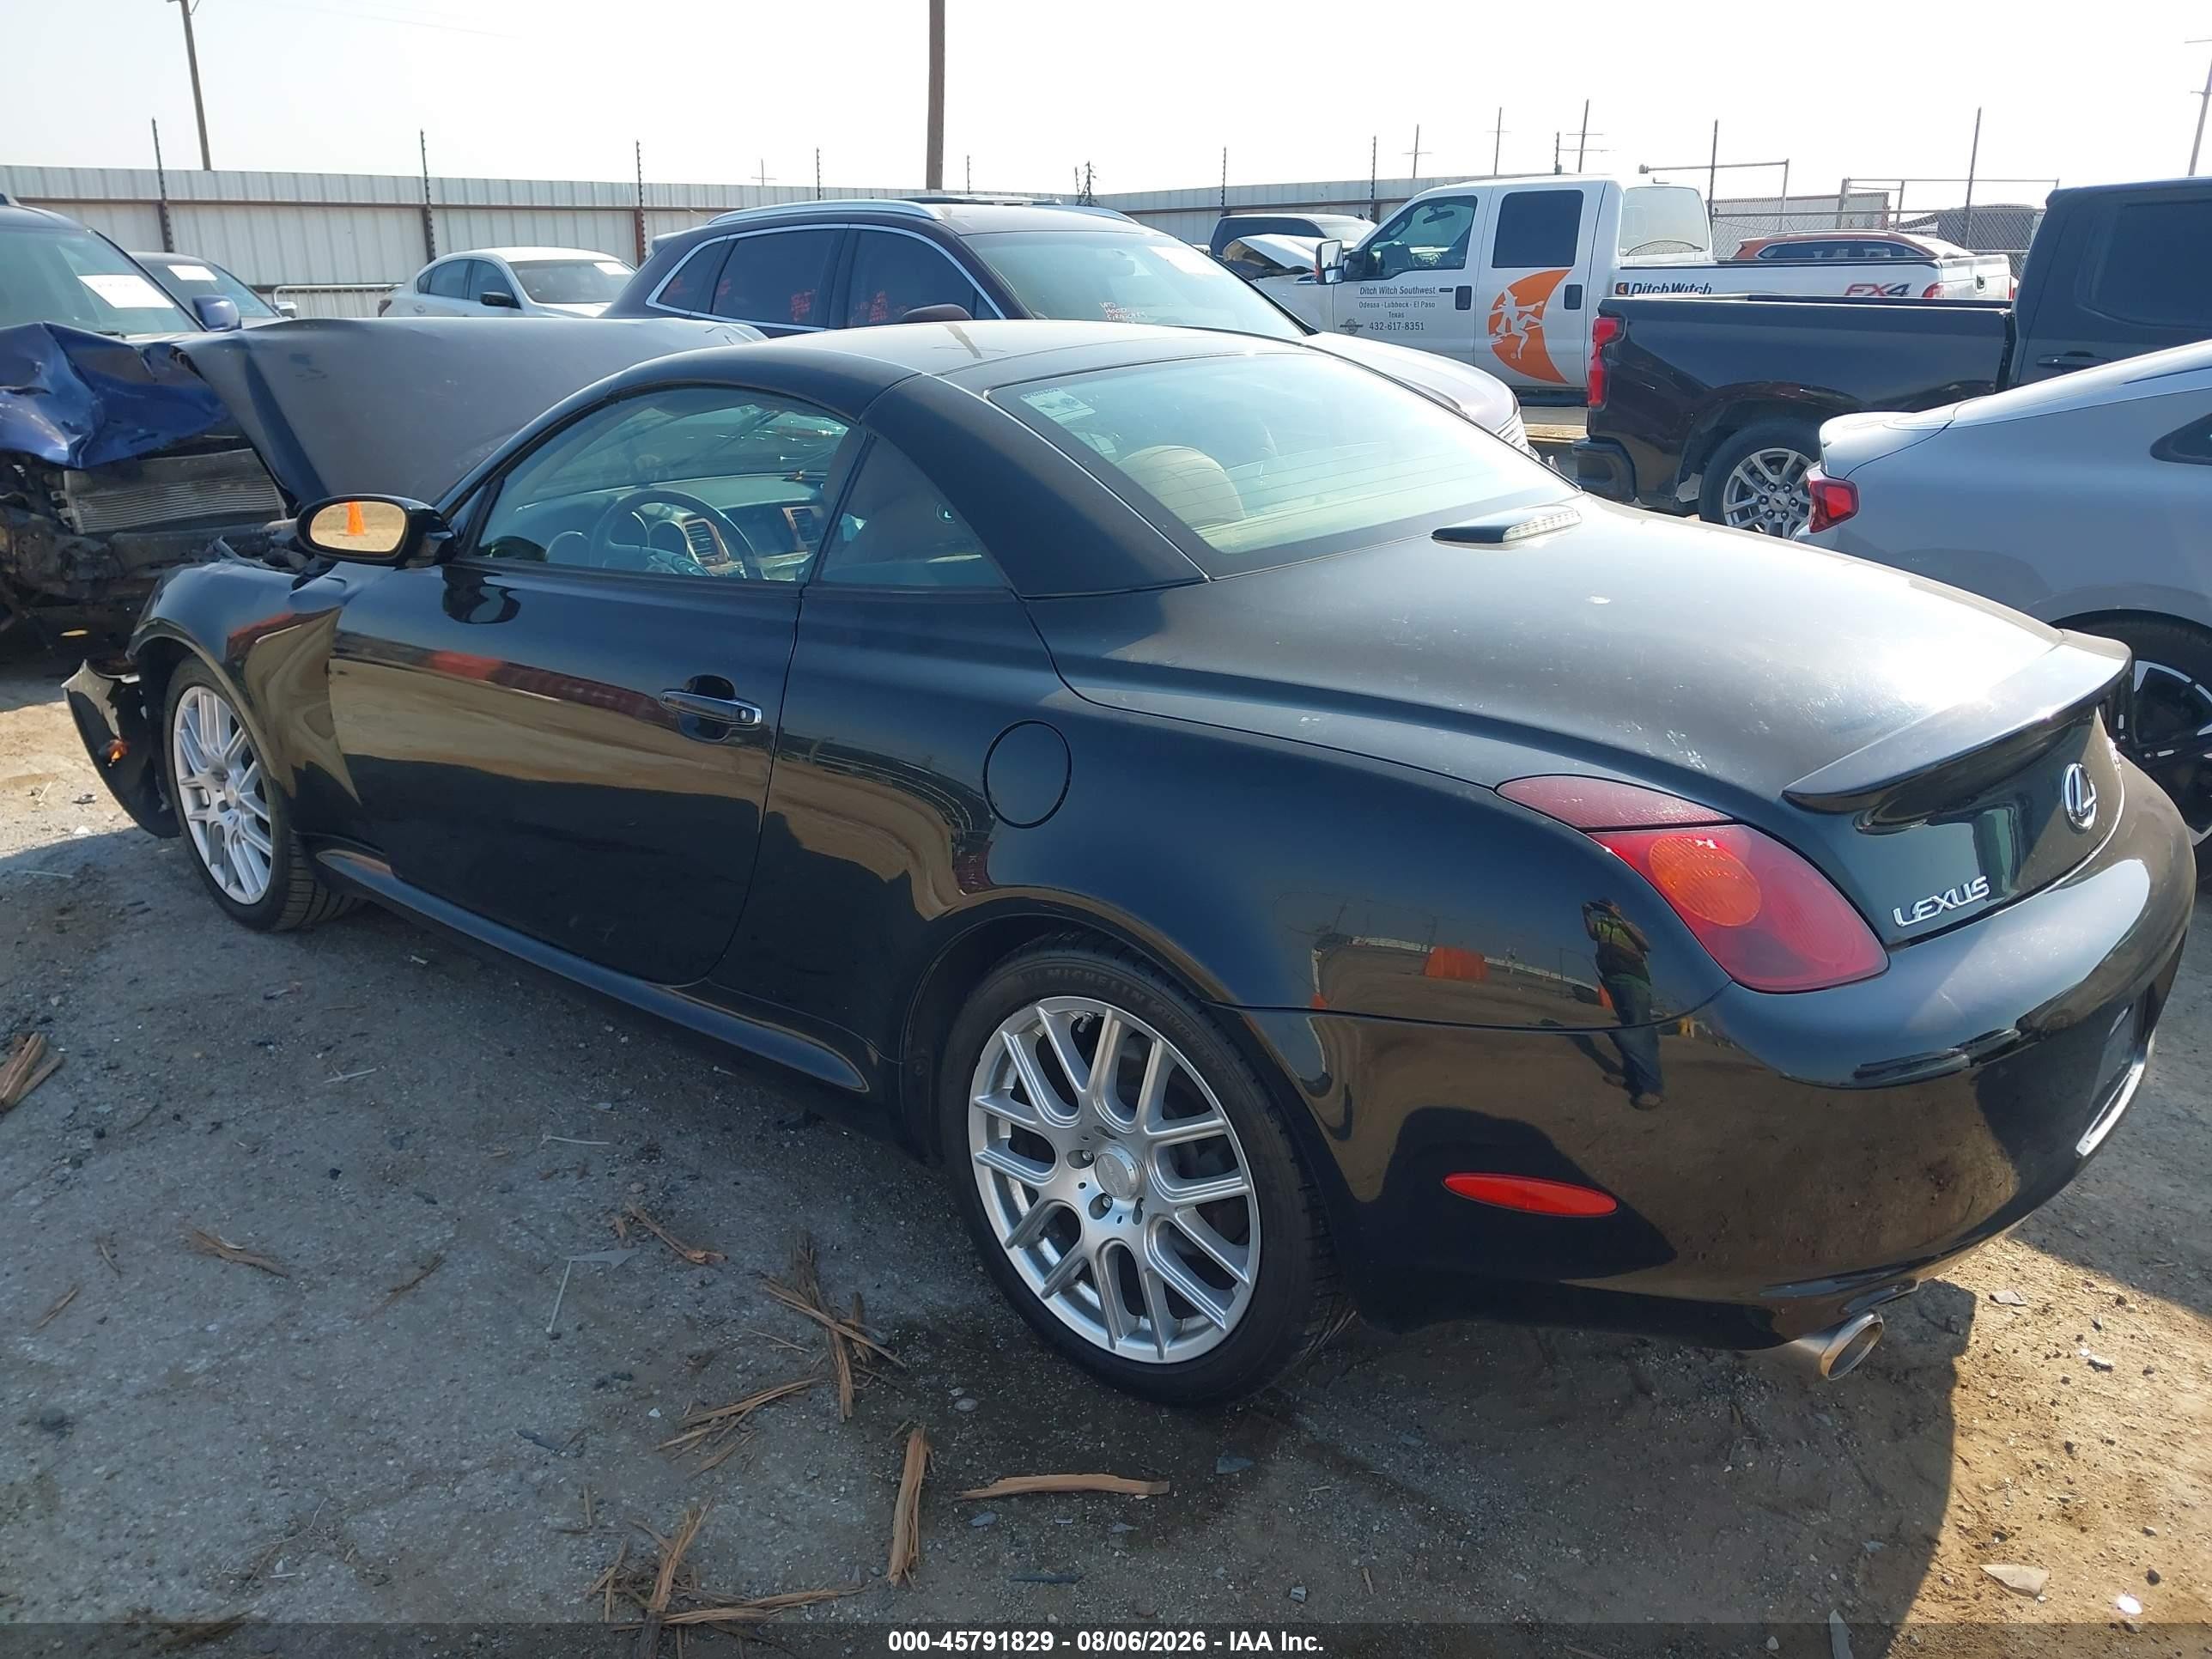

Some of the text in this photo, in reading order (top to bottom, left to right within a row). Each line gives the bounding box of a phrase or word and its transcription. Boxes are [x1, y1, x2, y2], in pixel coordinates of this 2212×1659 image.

[1359, 285, 1436, 295] Ditch Witch Southwest
[1632, 283, 1712, 295] Ditch Witch
[1844, 283, 1911, 296] FX4
[1369, 321, 1425, 331] 432-617-8351
[1893, 875, 1990, 927] LEXUS
[1048, 969, 1146, 1003] MICHELIN
